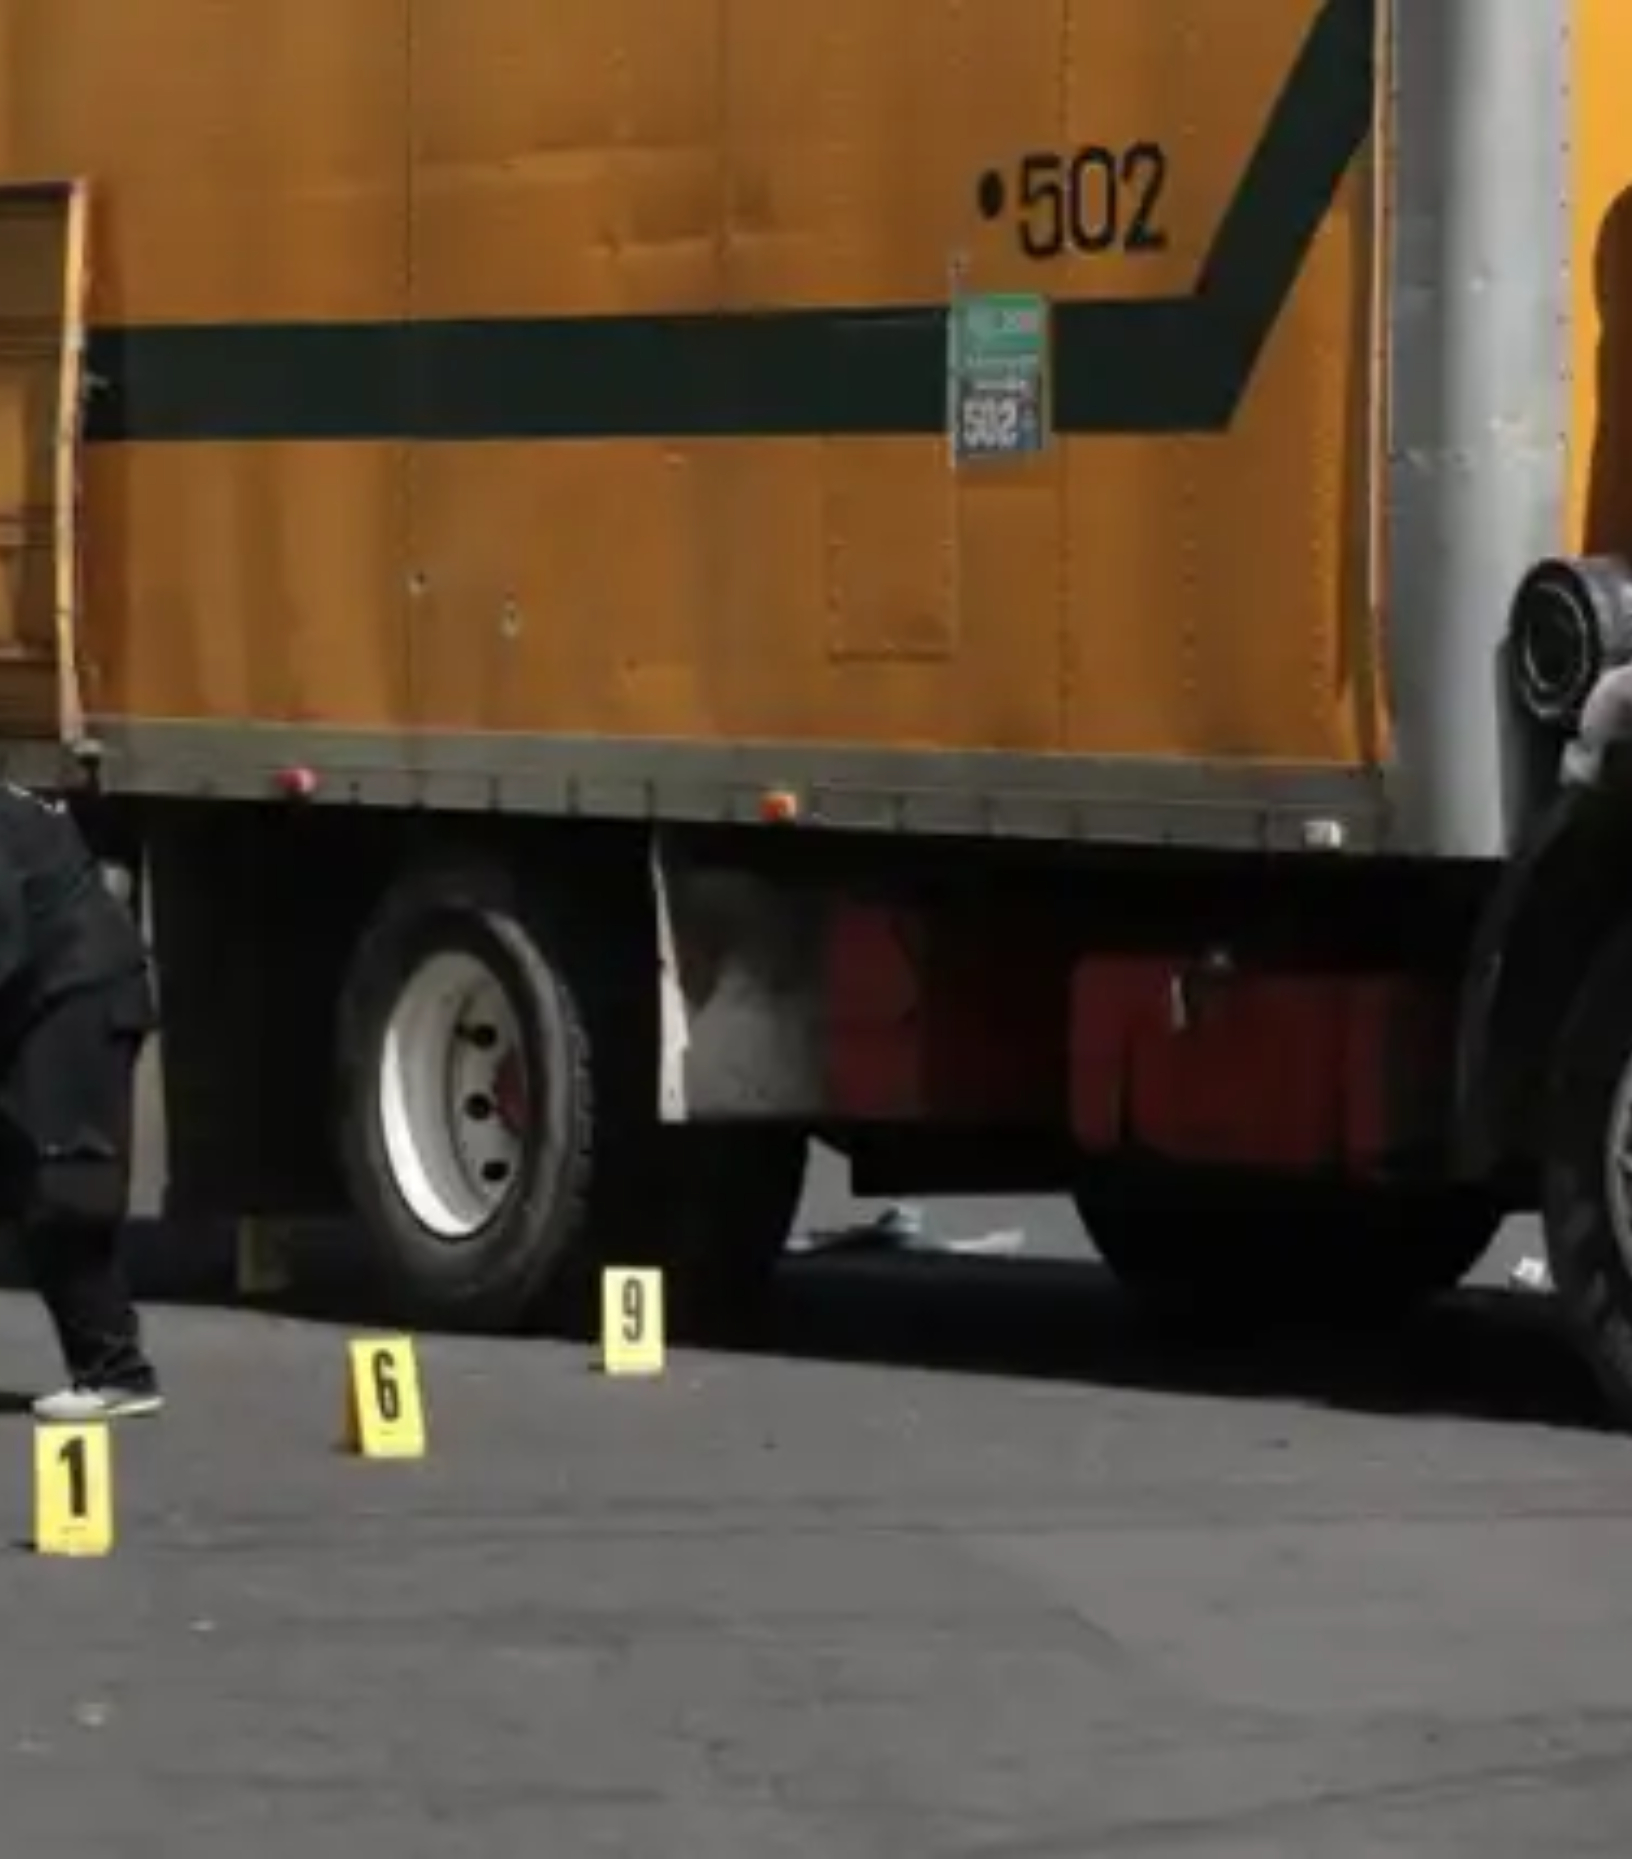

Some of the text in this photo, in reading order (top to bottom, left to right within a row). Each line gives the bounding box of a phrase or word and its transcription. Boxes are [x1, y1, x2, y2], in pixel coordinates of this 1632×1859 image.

[1020, 142, 1167, 258] 502
[621, 1278, 646, 1342] 9
[371, 1350, 400, 1422] 6
[58, 1437, 88, 1518] 1
